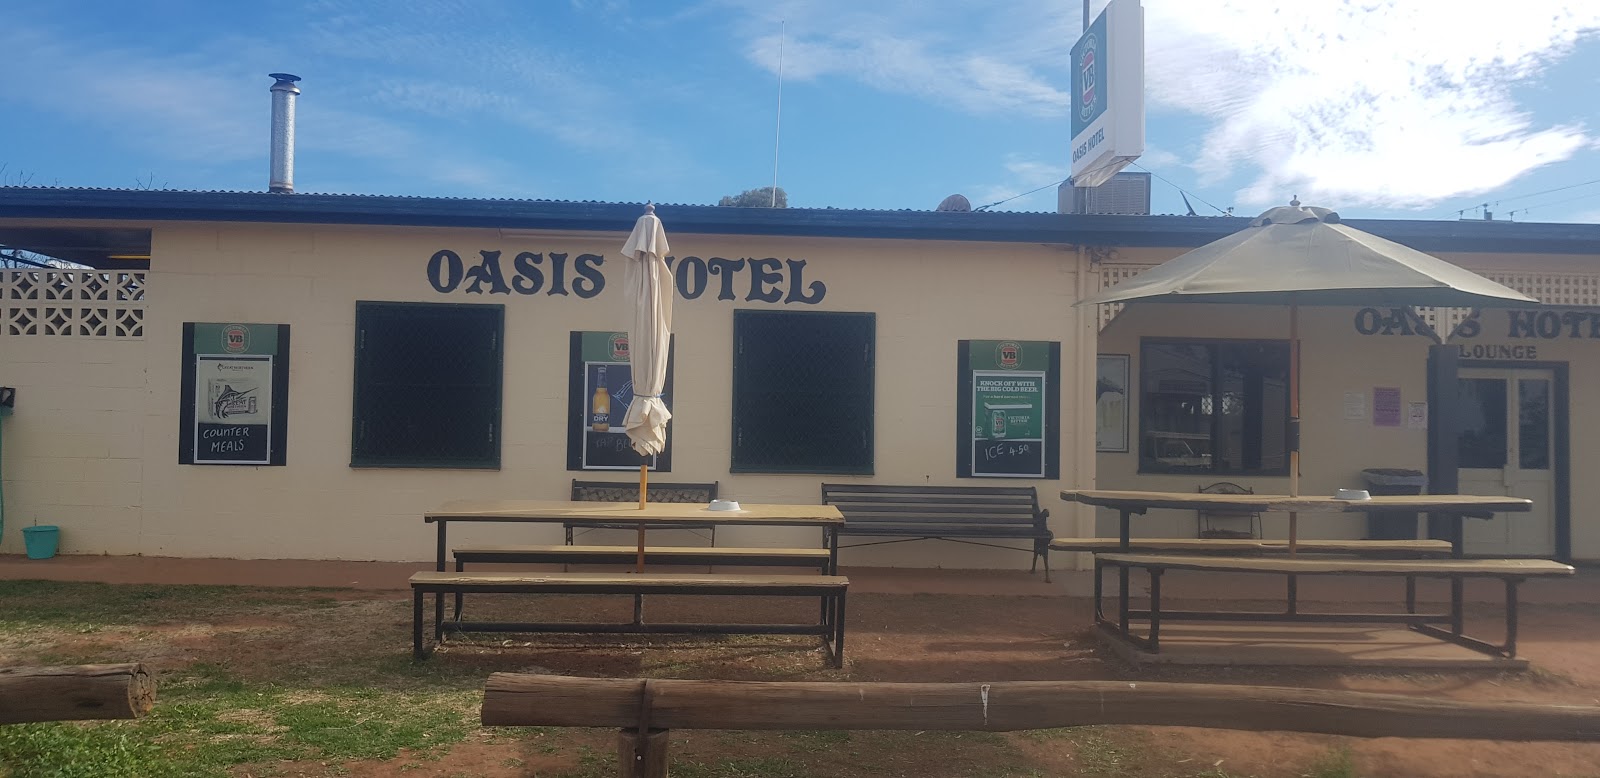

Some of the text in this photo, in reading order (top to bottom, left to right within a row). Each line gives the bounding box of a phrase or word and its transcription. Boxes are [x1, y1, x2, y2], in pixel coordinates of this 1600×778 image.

[1083, 64, 1094, 91] VB
[1073, 127, 1105, 164] OASIS HOTEL
[426, 249, 827, 305] OASIS OTEL
[615, 342, 629, 351] VB
[1457, 344, 1537, 360] LOUNGE
[203, 426, 250, 439] COUNTER
[211, 440, 244, 452] MEALS
[985, 443, 1004, 461] ICE
